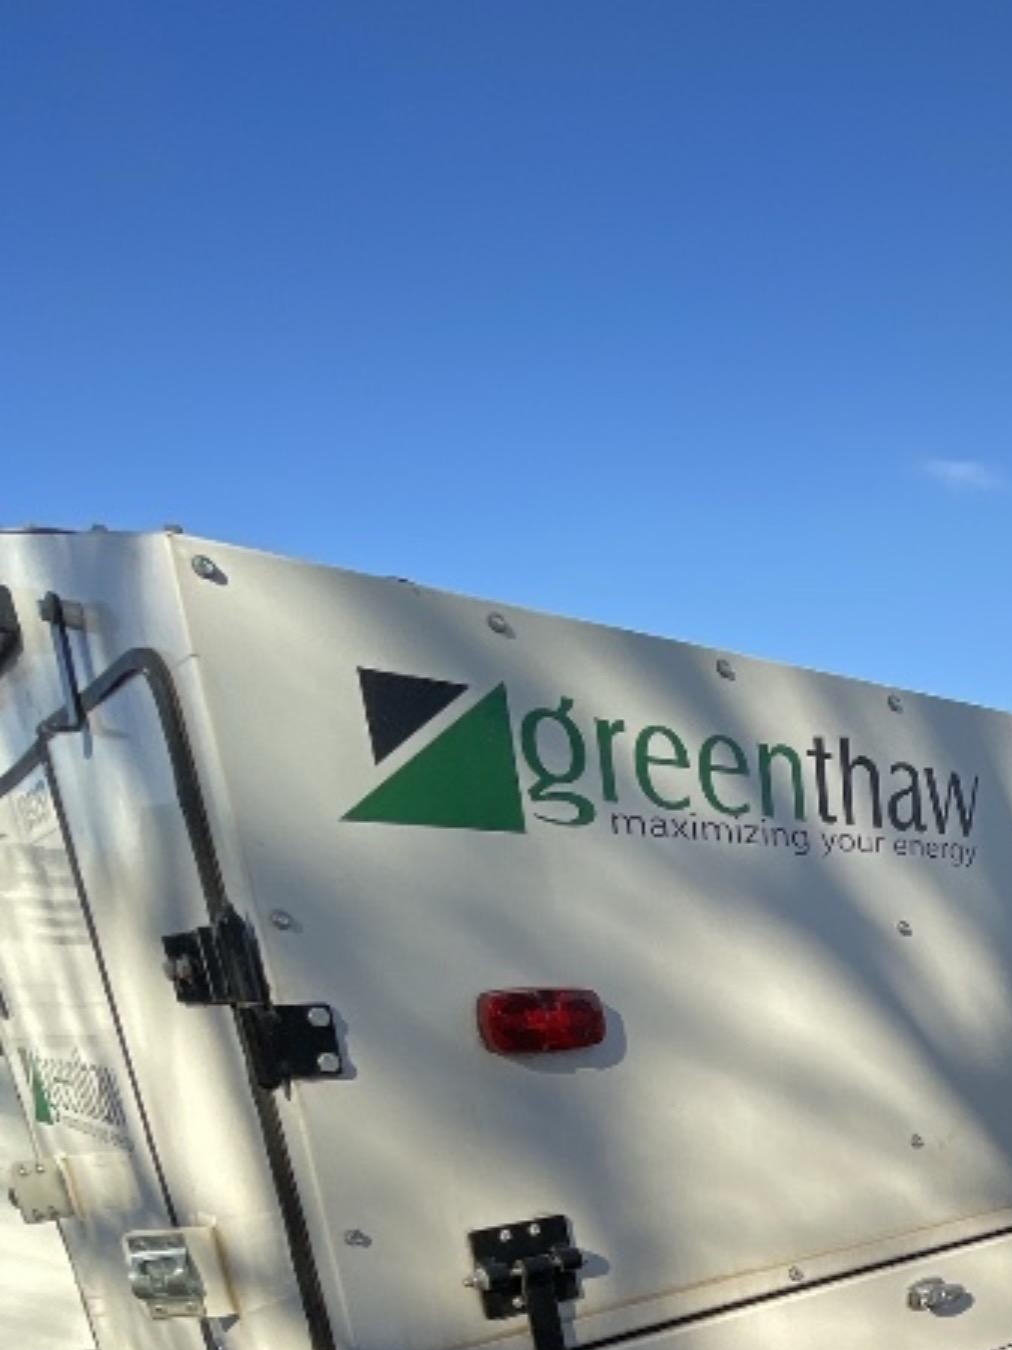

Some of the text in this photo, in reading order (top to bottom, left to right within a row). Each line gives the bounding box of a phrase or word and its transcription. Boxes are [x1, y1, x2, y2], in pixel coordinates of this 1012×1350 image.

[522, 695, 979, 838] greenthaw
[610, 811, 977, 869] maximizing your energy
